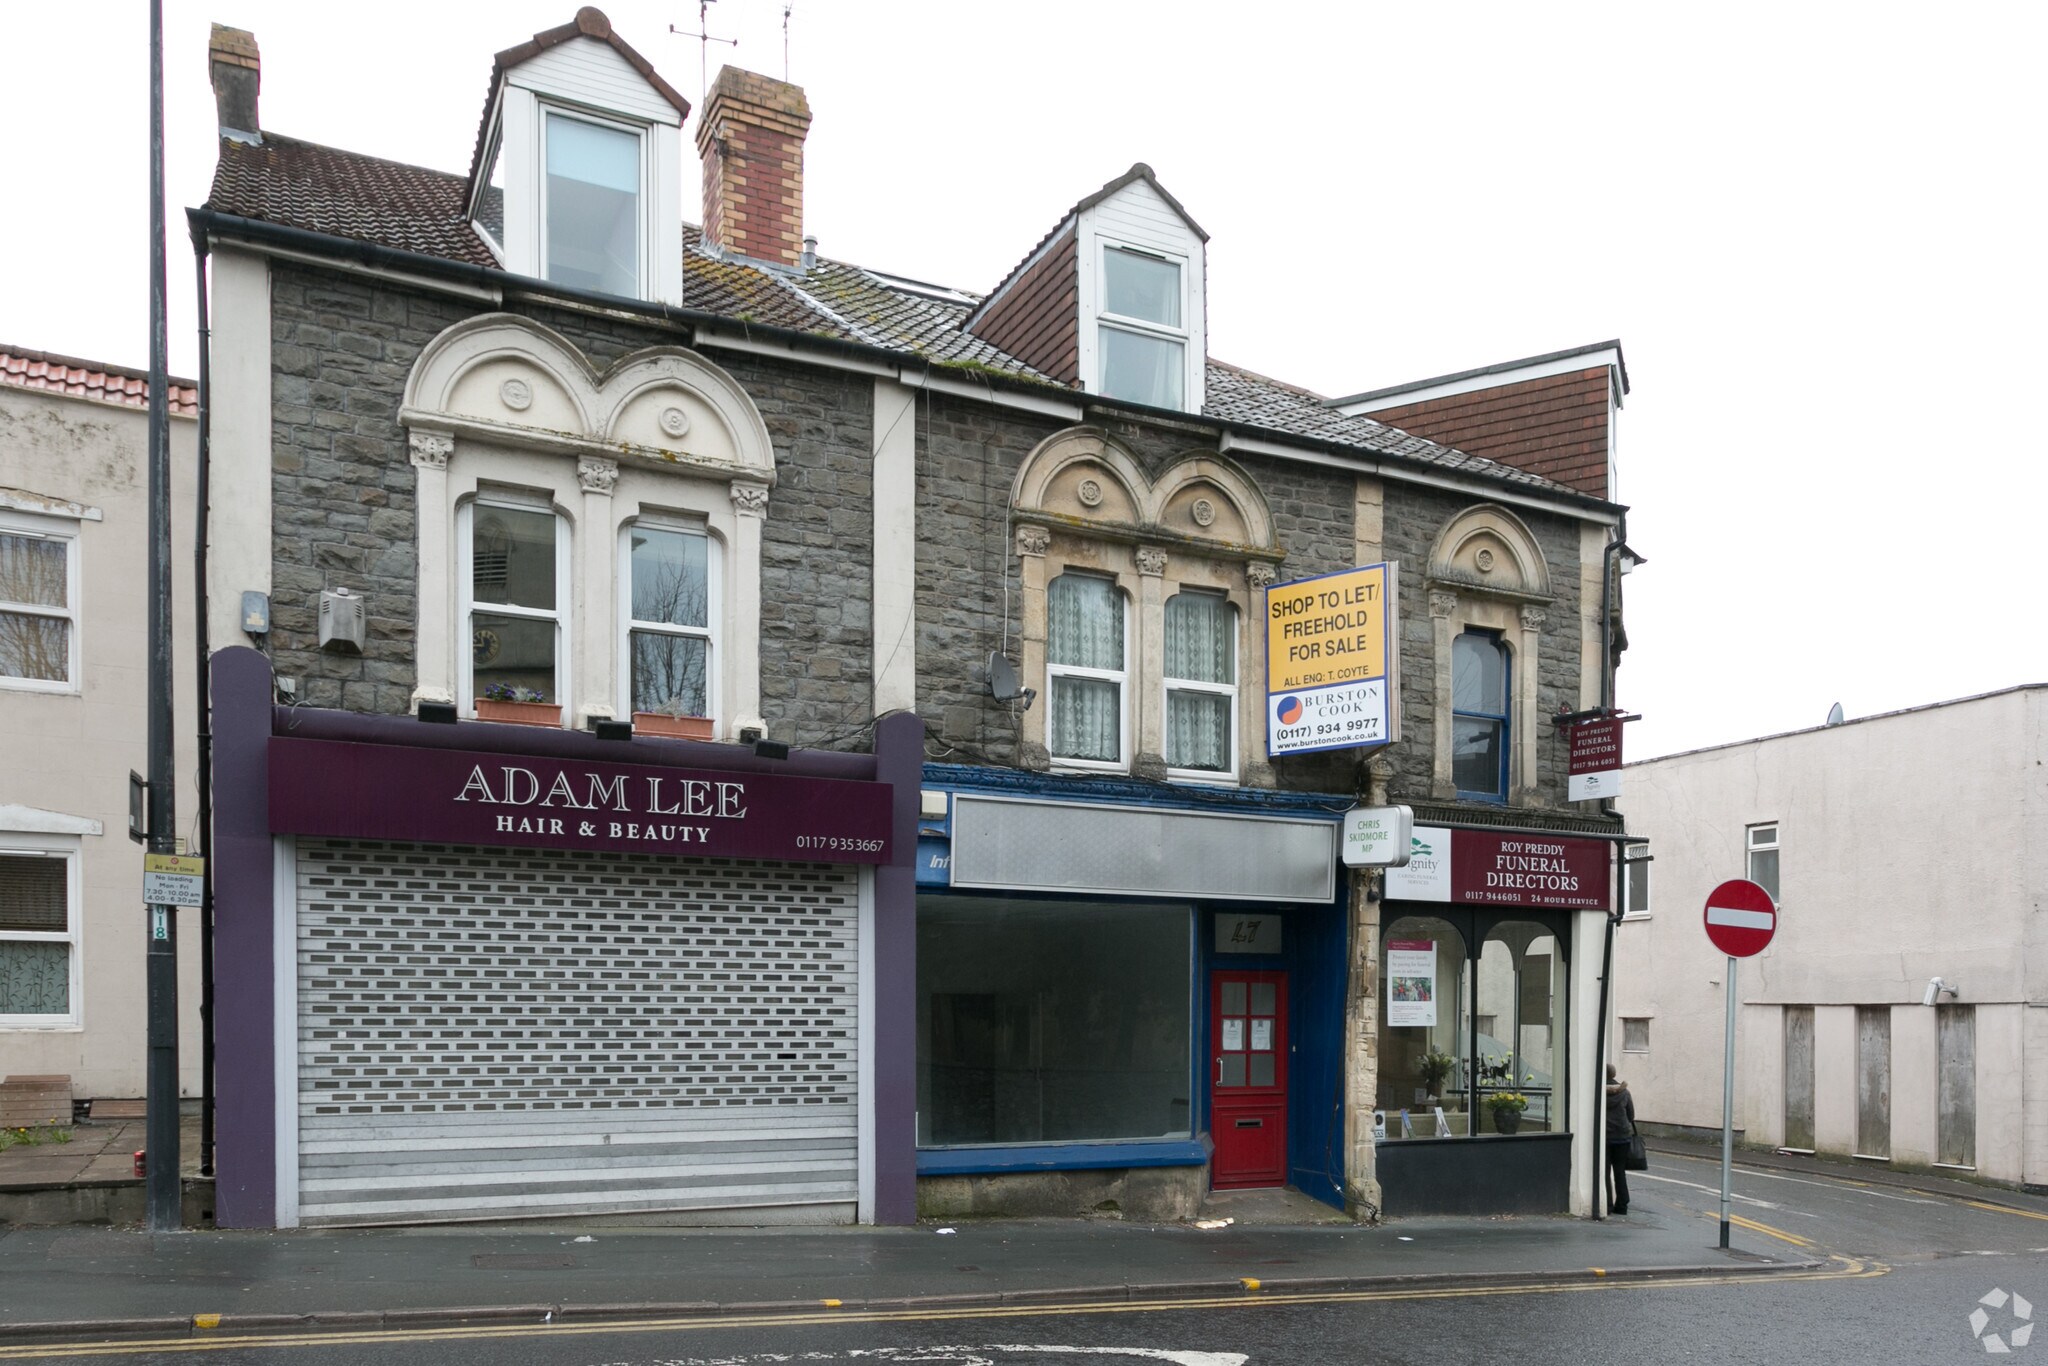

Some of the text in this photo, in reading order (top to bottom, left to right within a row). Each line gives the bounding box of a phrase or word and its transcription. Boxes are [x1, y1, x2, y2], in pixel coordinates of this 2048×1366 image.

[1272, 596, 1314, 618] SHOP
[1318, 591, 1339, 609] TO
[1284, 610, 1367, 639] FREEHOLD
[1290, 634, 1366, 662] FOR SALE
[1284, 665, 1369, 687] ALL ENQ: T. COYTE
[1305, 687, 1378, 707] BURSTON
[1318, 701, 1363, 718] COOK
[1276, 717, 1378, 741] (0117) 934 9977
[1590, 726, 1613, 735] PREDDY
[1277, 731, 1378, 750] www.burstoncook.co.uk
[1577, 735, 1612, 746] FUNERAL
[1573, 744, 1616, 757] DIRECTORS
[1572, 761, 1586, 769] 0117
[453, 764, 748, 819] ADAM LEE
[496, 815, 710, 843] HAIR & BEAUTY
[1357, 820, 1380, 830] CHRIS
[1349, 831, 1389, 842] SKIDMORE
[1362, 844, 1373, 853] MP
[1501, 841, 1565, 856] ROY PREDDY
[929, 854, 951, 869] Inf
[1406, 857, 1438, 873] ignity
[1496, 855, 1570, 873] FUNERAL
[167, 875, 193, 884] loading
[1486, 872, 1578, 891] DIRECTORS
[1465, 891, 1598, 905] 0117 9446051 24 HOUR SERVICE
